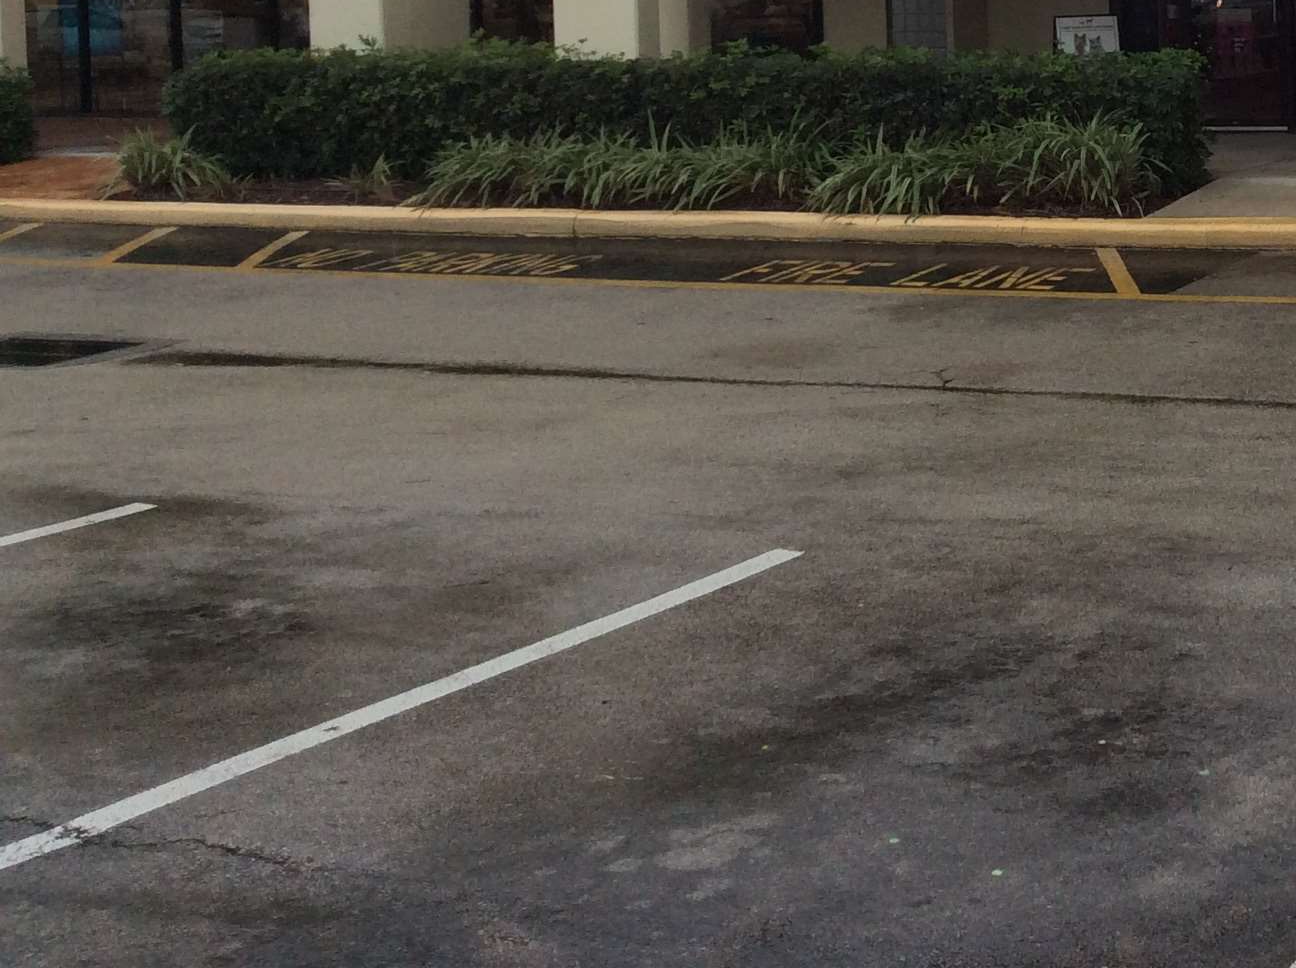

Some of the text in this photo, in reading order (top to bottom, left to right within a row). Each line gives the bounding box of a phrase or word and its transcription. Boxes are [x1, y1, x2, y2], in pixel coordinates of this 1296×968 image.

[262, 247, 602, 275] NO PARKING
[720, 259, 1097, 291] FIRE LANE
